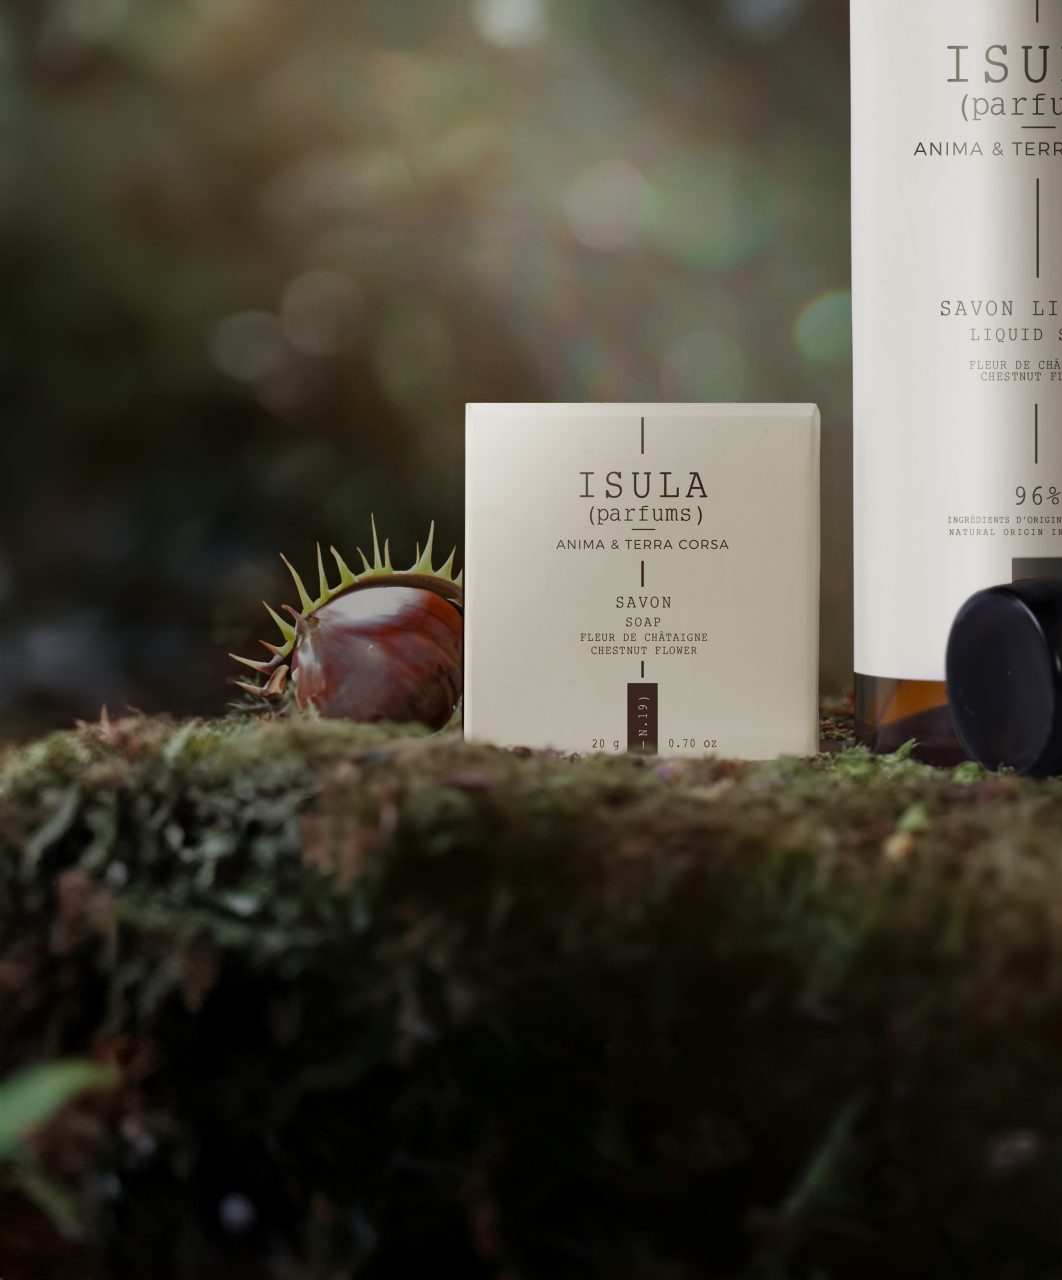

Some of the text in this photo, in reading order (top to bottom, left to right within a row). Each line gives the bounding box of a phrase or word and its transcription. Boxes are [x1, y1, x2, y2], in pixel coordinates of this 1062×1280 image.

[913, 141, 984, 157] ANIMA
[991, 141, 1005, 157] &
[940, 299, 1014, 317] SAVON
[969, 327, 1043, 344] LIQUID
[968, 360, 1008, 370] FLEUR
[1015, 359, 1031, 370] DE
[980, 371, 1042, 382] CHESTNUT
[578, 470, 709, 499] ISULA
[1015, 485, 1062, 506] 96%
[589, 505, 703, 527] (parfums)
[947, 513, 1010, 526] INGRÉDIENTS
[948, 528, 996, 537] NATURAL
[1002, 528, 1044, 536] ORIGIN
[555, 538, 729, 551] ANIMA & TERRA CORSA
[615, 595, 672, 609] SAVON
[623, 616, 662, 628] SOAP
[579, 630, 708, 642] FLEUR DE CHÂTAIGNE
[590, 645, 698, 656] CHESTNUT FLOWER
[591, 738, 620, 751] 20 g
[668, 738, 718, 749] 0.70 oz
